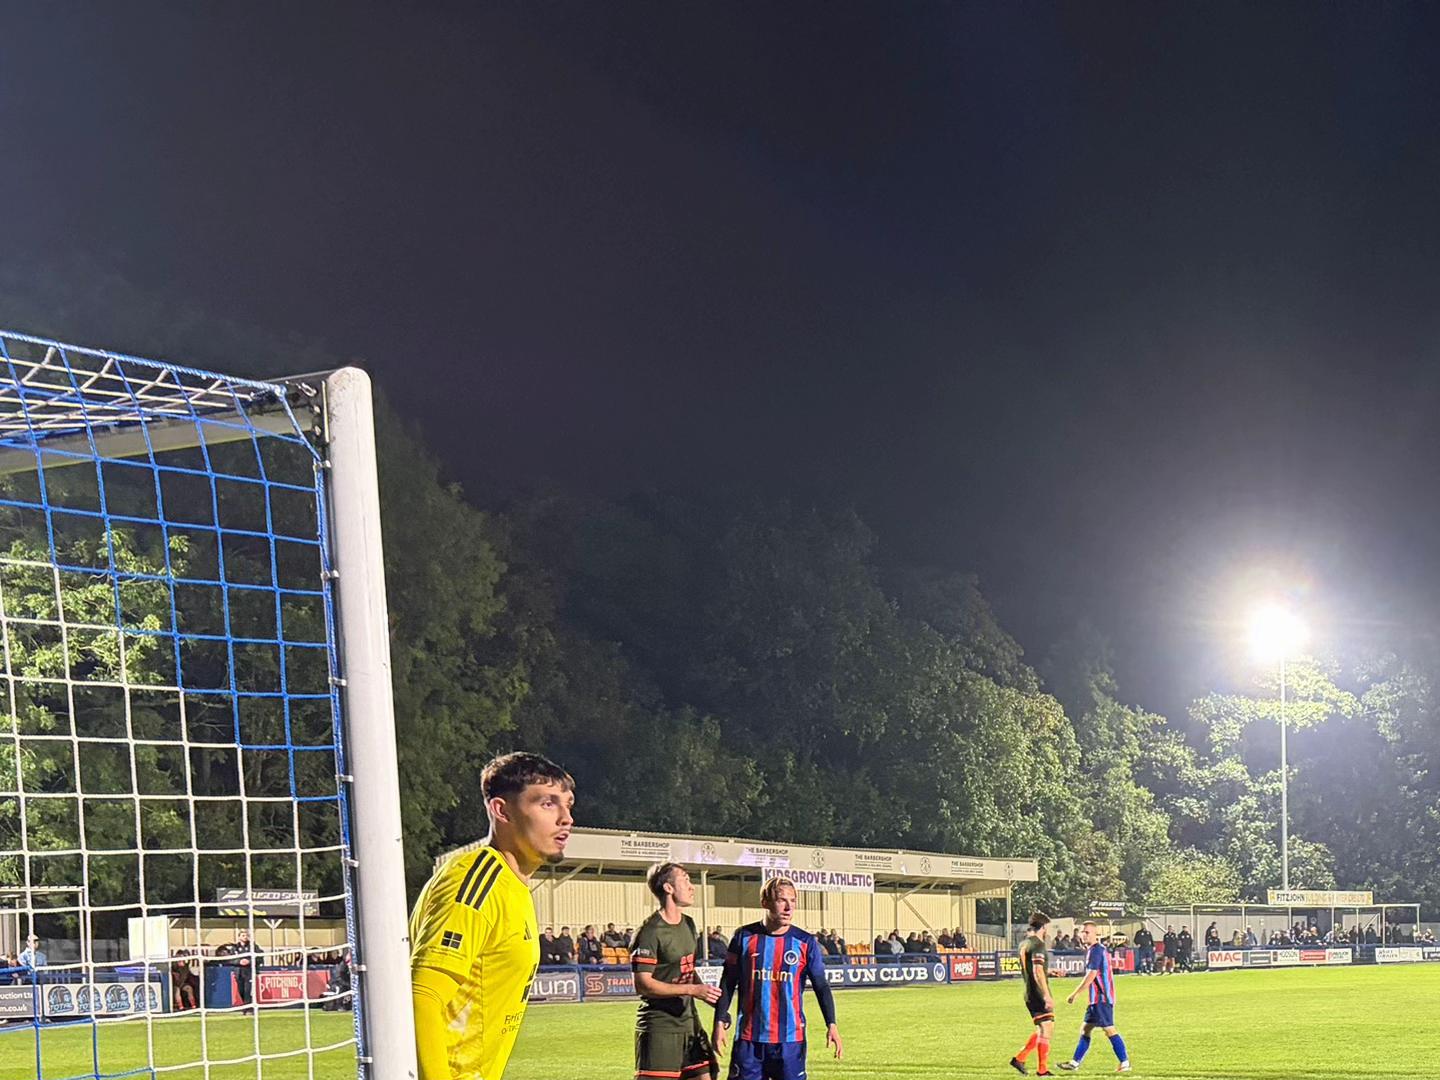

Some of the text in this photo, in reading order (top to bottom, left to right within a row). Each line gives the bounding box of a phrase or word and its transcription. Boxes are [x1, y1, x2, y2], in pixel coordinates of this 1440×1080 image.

[829, 872, 872, 888] ATHLETIC
[1276, 893, 1305, 902] FITZJOHN
[1210, 952, 1242, 962] MAC
[848, 968, 877, 982] UN
[880, 966, 928, 981] CLUB
[265, 975, 298, 988] PITCHING
[107, 1001, 131, 1011] TOTAL
